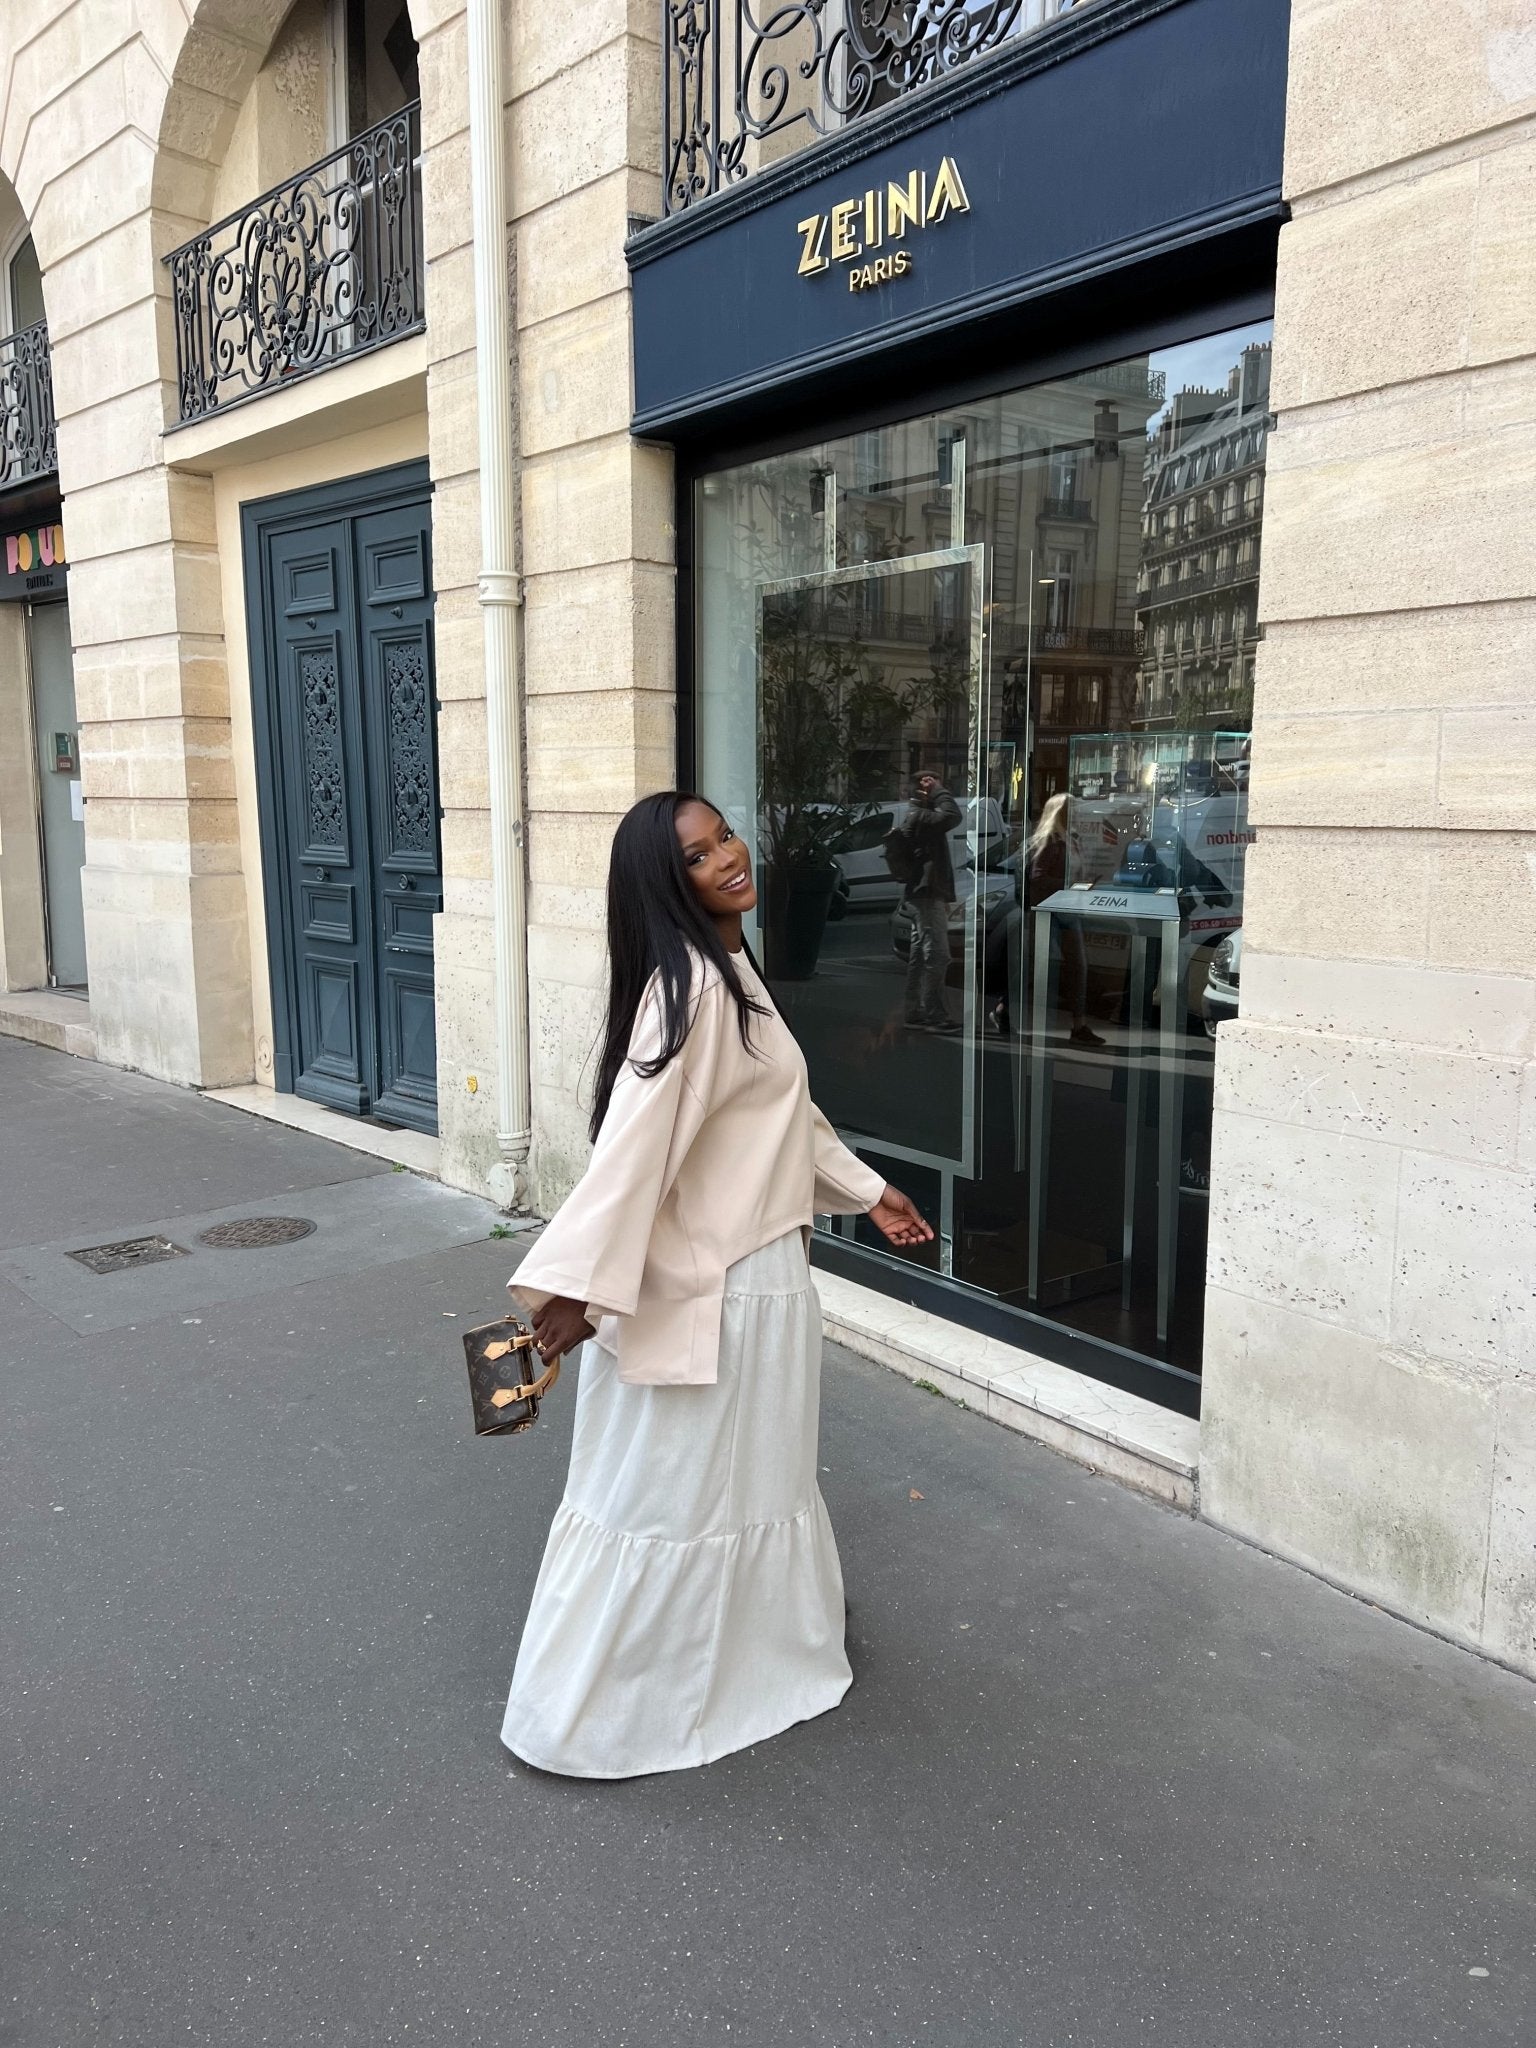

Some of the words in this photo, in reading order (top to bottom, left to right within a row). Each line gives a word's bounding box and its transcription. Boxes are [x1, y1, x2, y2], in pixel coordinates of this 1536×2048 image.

[798, 156, 969, 276] ZEINA
[850, 250, 911, 292] PARIS
[1089, 895, 1128, 908] ZEINA
